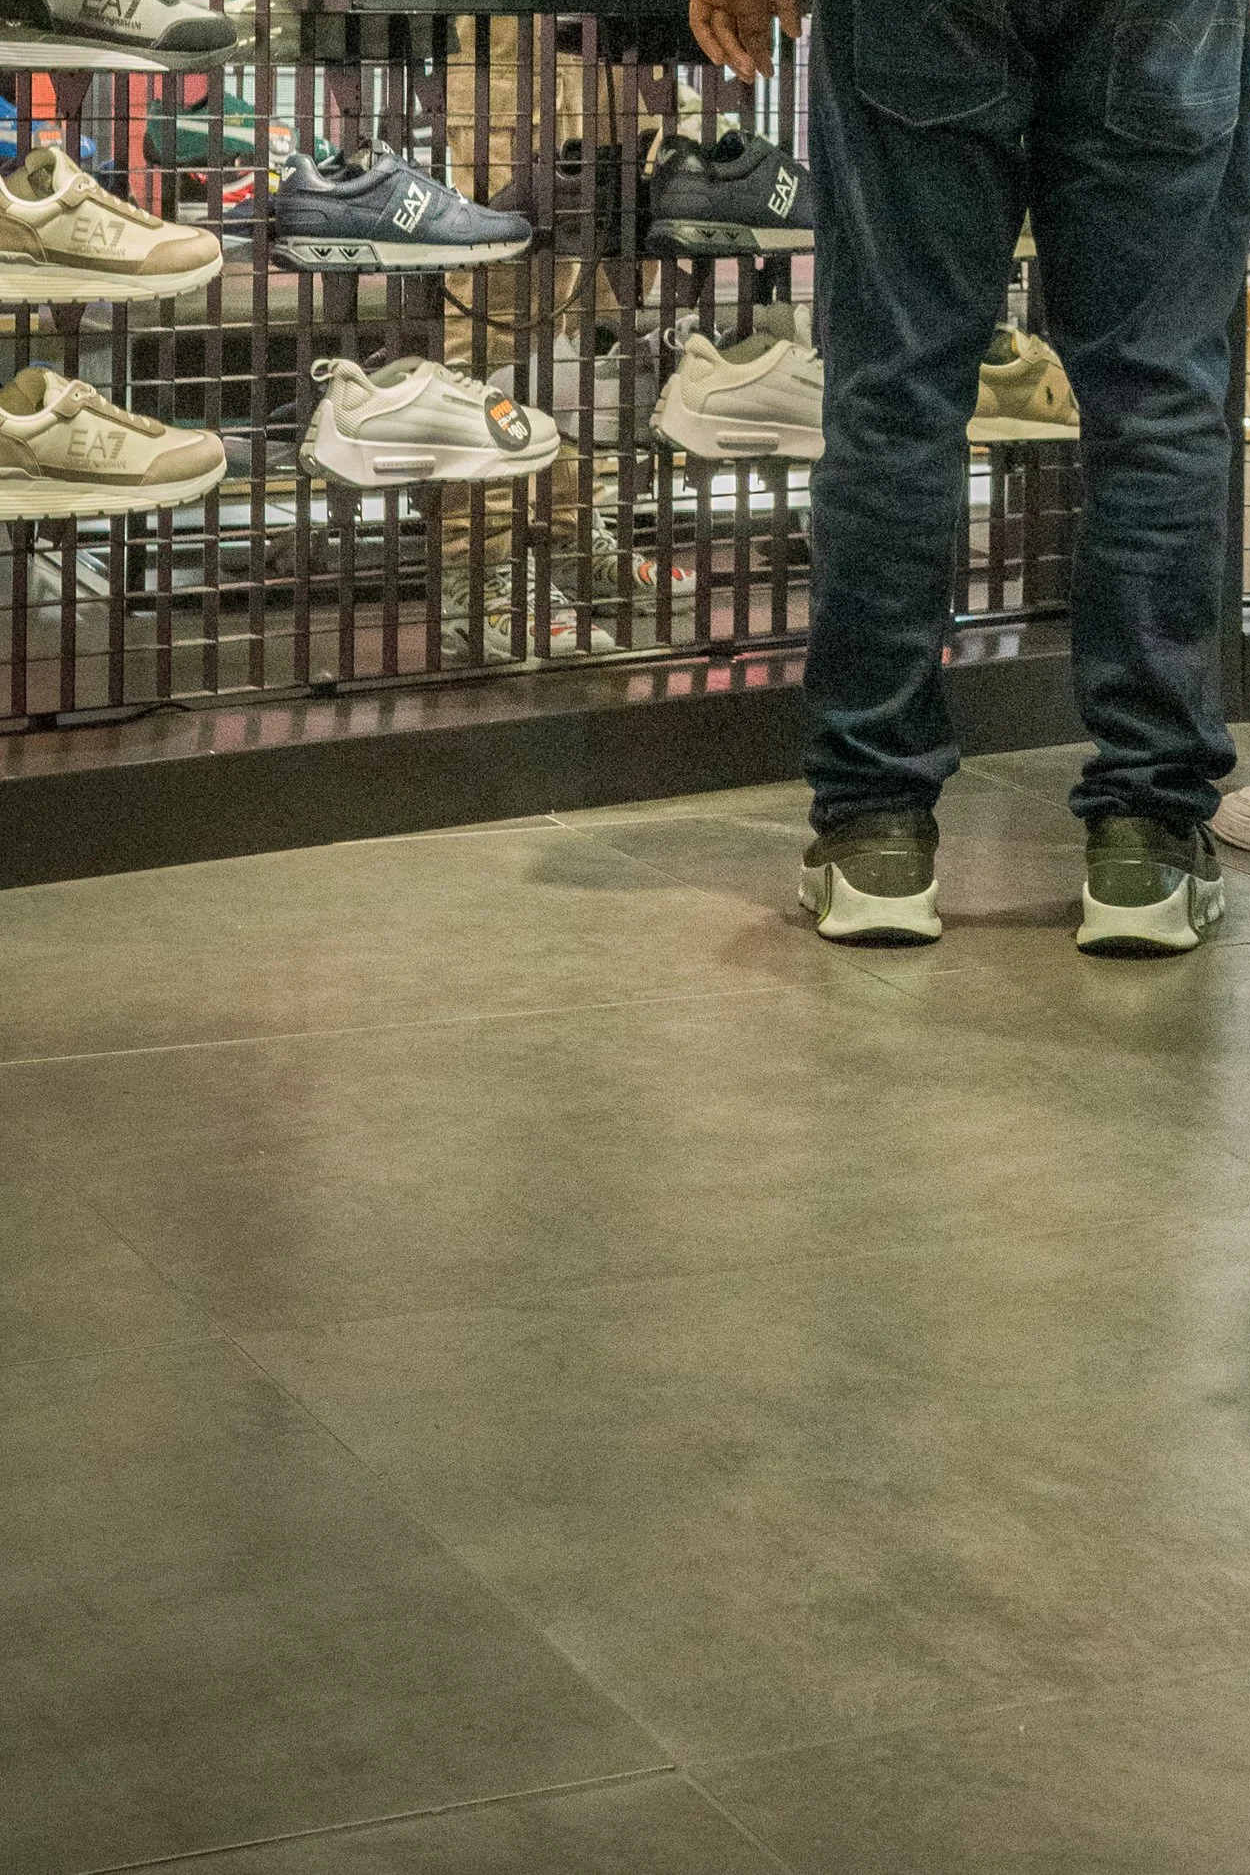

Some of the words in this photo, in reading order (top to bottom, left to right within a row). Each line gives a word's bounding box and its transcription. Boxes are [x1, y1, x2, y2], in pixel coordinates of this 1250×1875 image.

[393, 181, 426, 231] EA7
[768, 166, 794, 216] EA7
[70, 215, 126, 248] EA7
[67, 428, 127, 460] EA7
